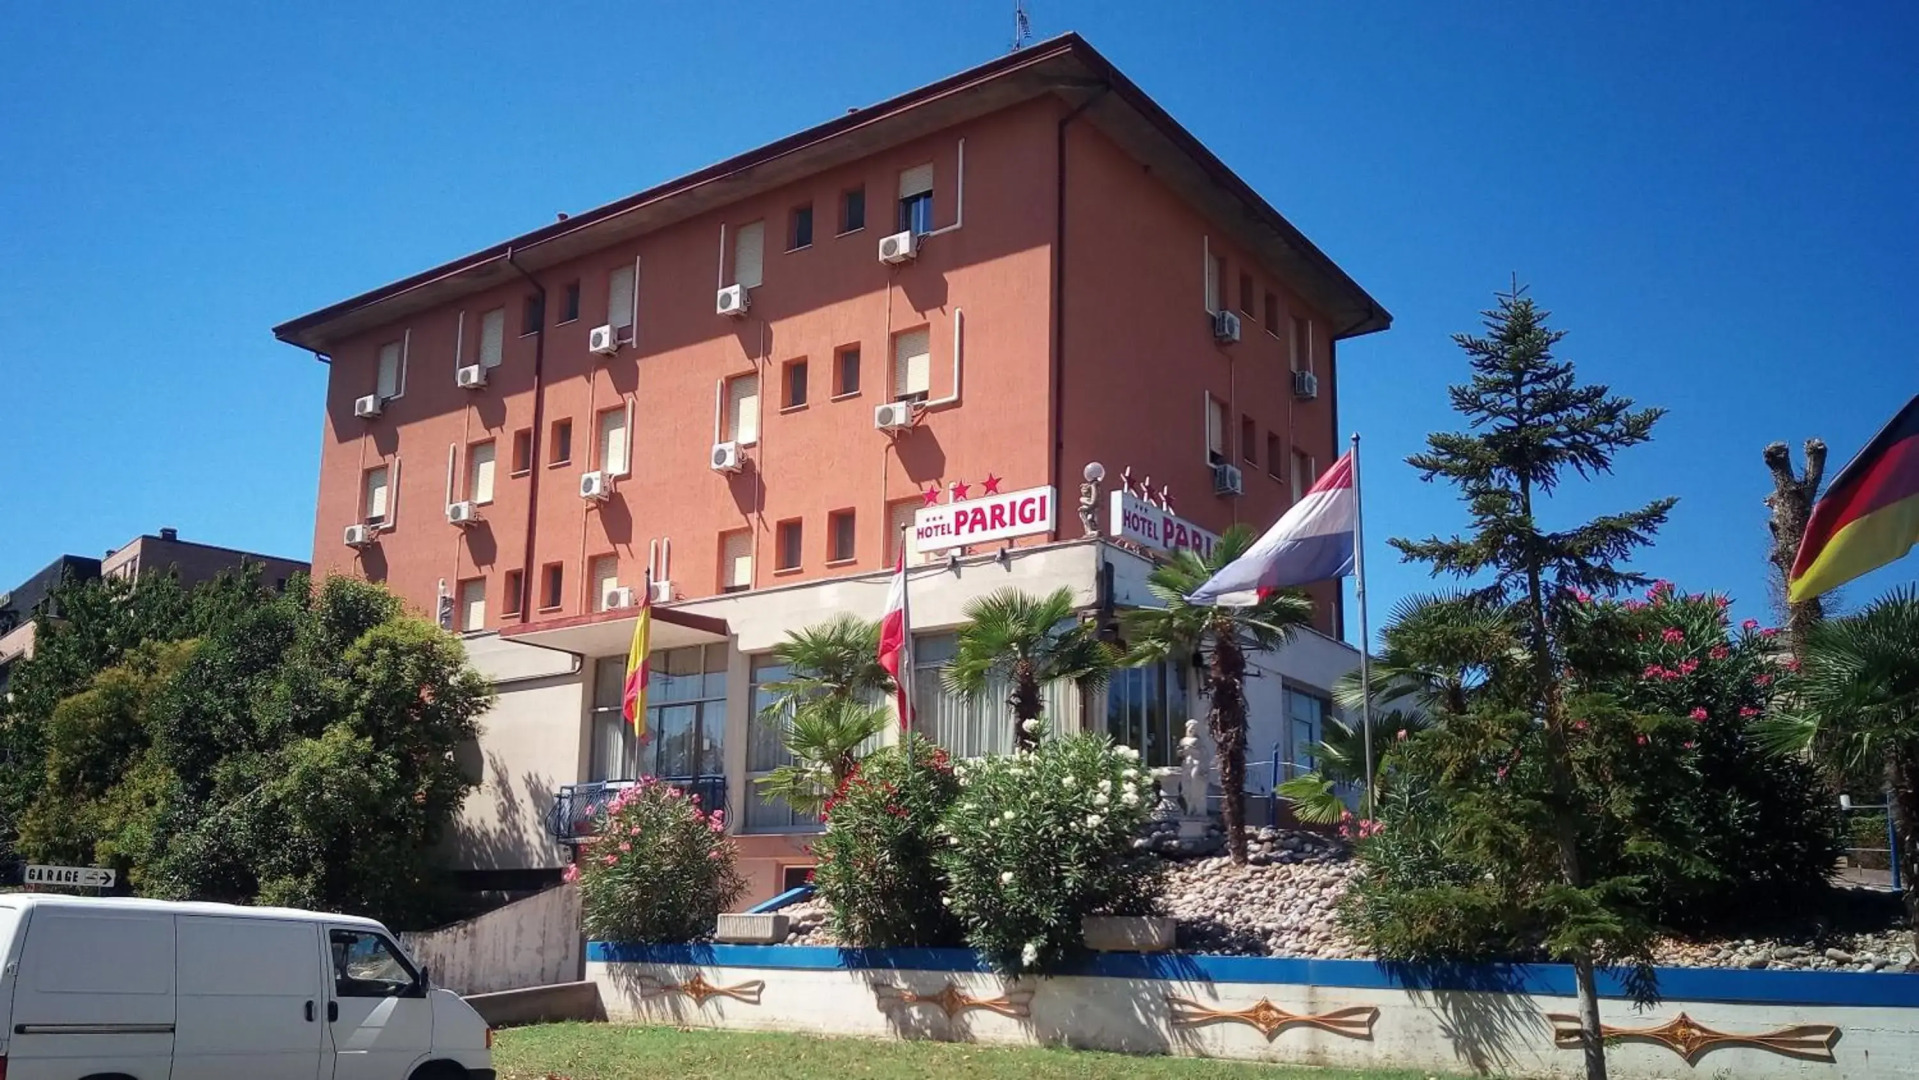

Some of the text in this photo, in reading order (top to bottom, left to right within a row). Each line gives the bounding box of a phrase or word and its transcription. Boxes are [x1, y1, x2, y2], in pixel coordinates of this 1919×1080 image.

[917, 495, 1047, 540] HOTEL PARIGI
[1123, 508, 1159, 541] HOTEL
[28, 868, 79, 883] GARAGE
